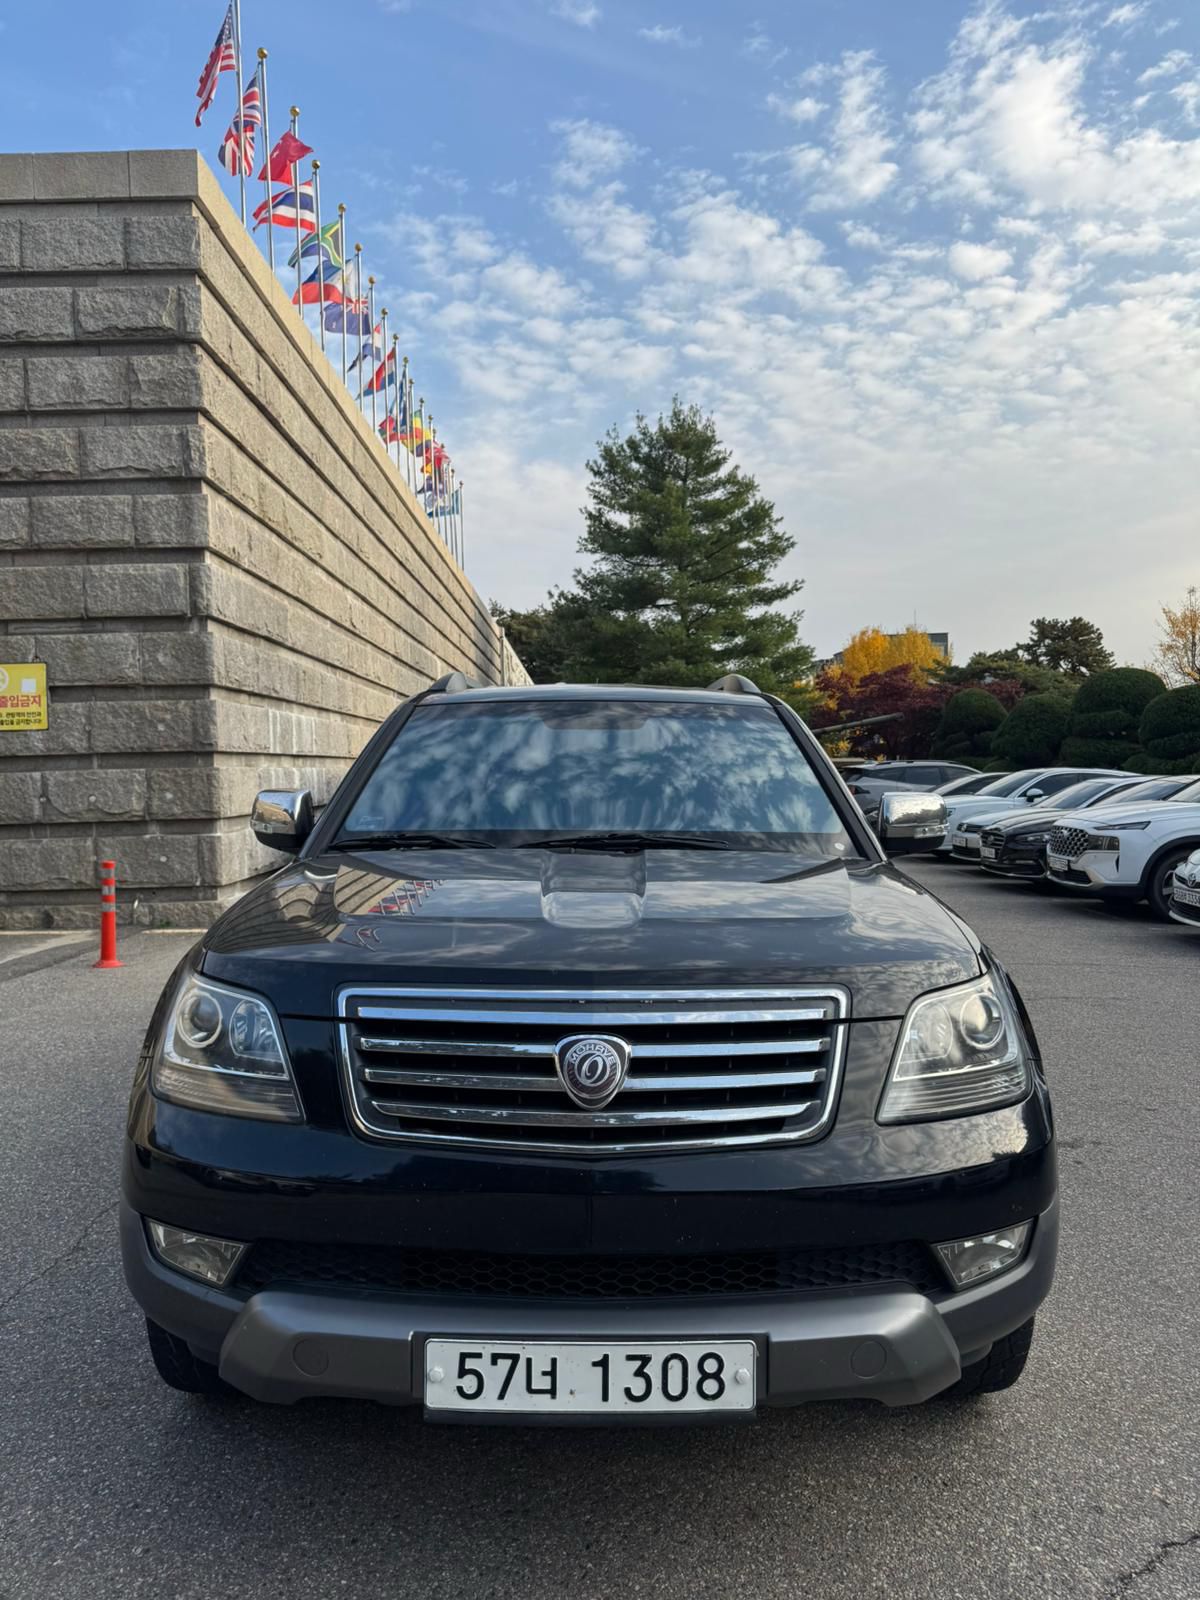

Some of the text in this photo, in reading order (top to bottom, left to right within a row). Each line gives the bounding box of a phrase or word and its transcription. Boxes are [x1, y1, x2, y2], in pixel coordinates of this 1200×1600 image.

[569, 1043, 617, 1065] MOHAVE
[455, 1351, 727, 1403] 57너 1308
